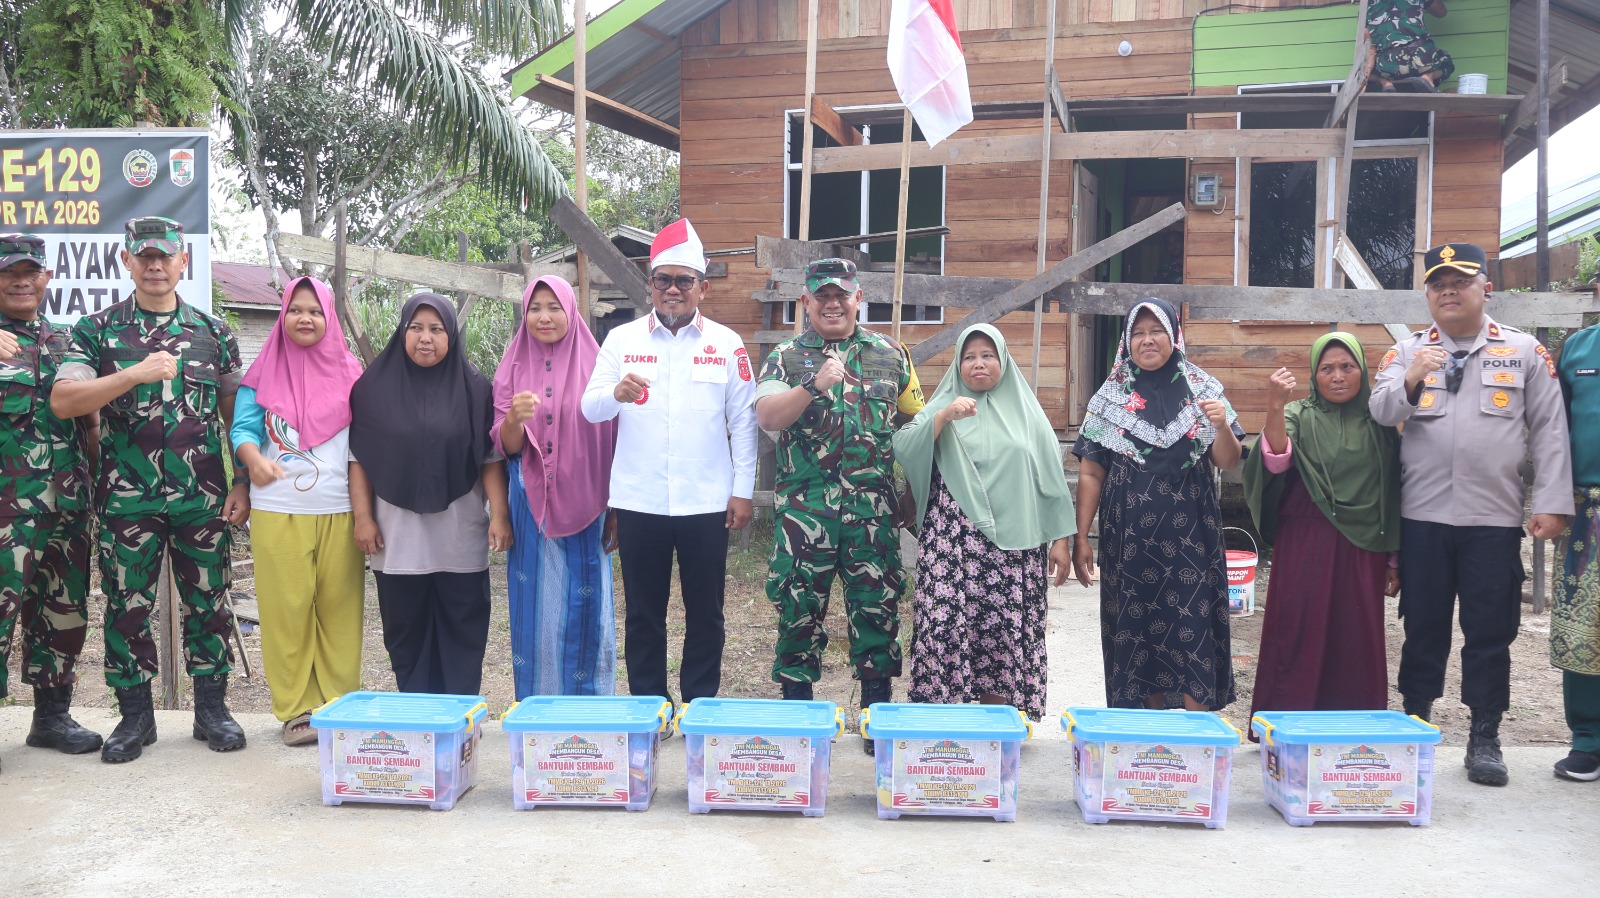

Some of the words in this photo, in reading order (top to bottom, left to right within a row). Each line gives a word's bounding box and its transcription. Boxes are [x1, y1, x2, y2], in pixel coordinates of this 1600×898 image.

[0, 148, 101, 193] E-129
[0, 200, 18, 225] R
[21, 200, 49, 225] TA
[53, 200, 99, 225] 2026
[51, 242, 121, 280] AYAK
[623, 354, 657, 364] ZUKRI
[693, 356, 727, 367] BUPATI
[1482, 359, 1521, 368] POLRI
[865, 369, 882, 377] TNI
[347, 756, 381, 765] BANTUAN
[384, 758, 420, 767] SEMBAKO
[538, 762, 574, 770] BANTUAN
[577, 762, 614, 770] SEMBAKO
[719, 762, 755, 771] BANTUAN
[758, 763, 795, 772] SEMBAKO
[908, 766, 944, 774] BANTUAN
[947, 766, 985, 775] SEMBAKO
[1118, 770, 1155, 780] BANTUAN
[1159, 772, 1198, 783] SEMBAKO
[1323, 773, 1360, 781] BANTUAN
[1364, 773, 1401, 781] SEMBAKO
